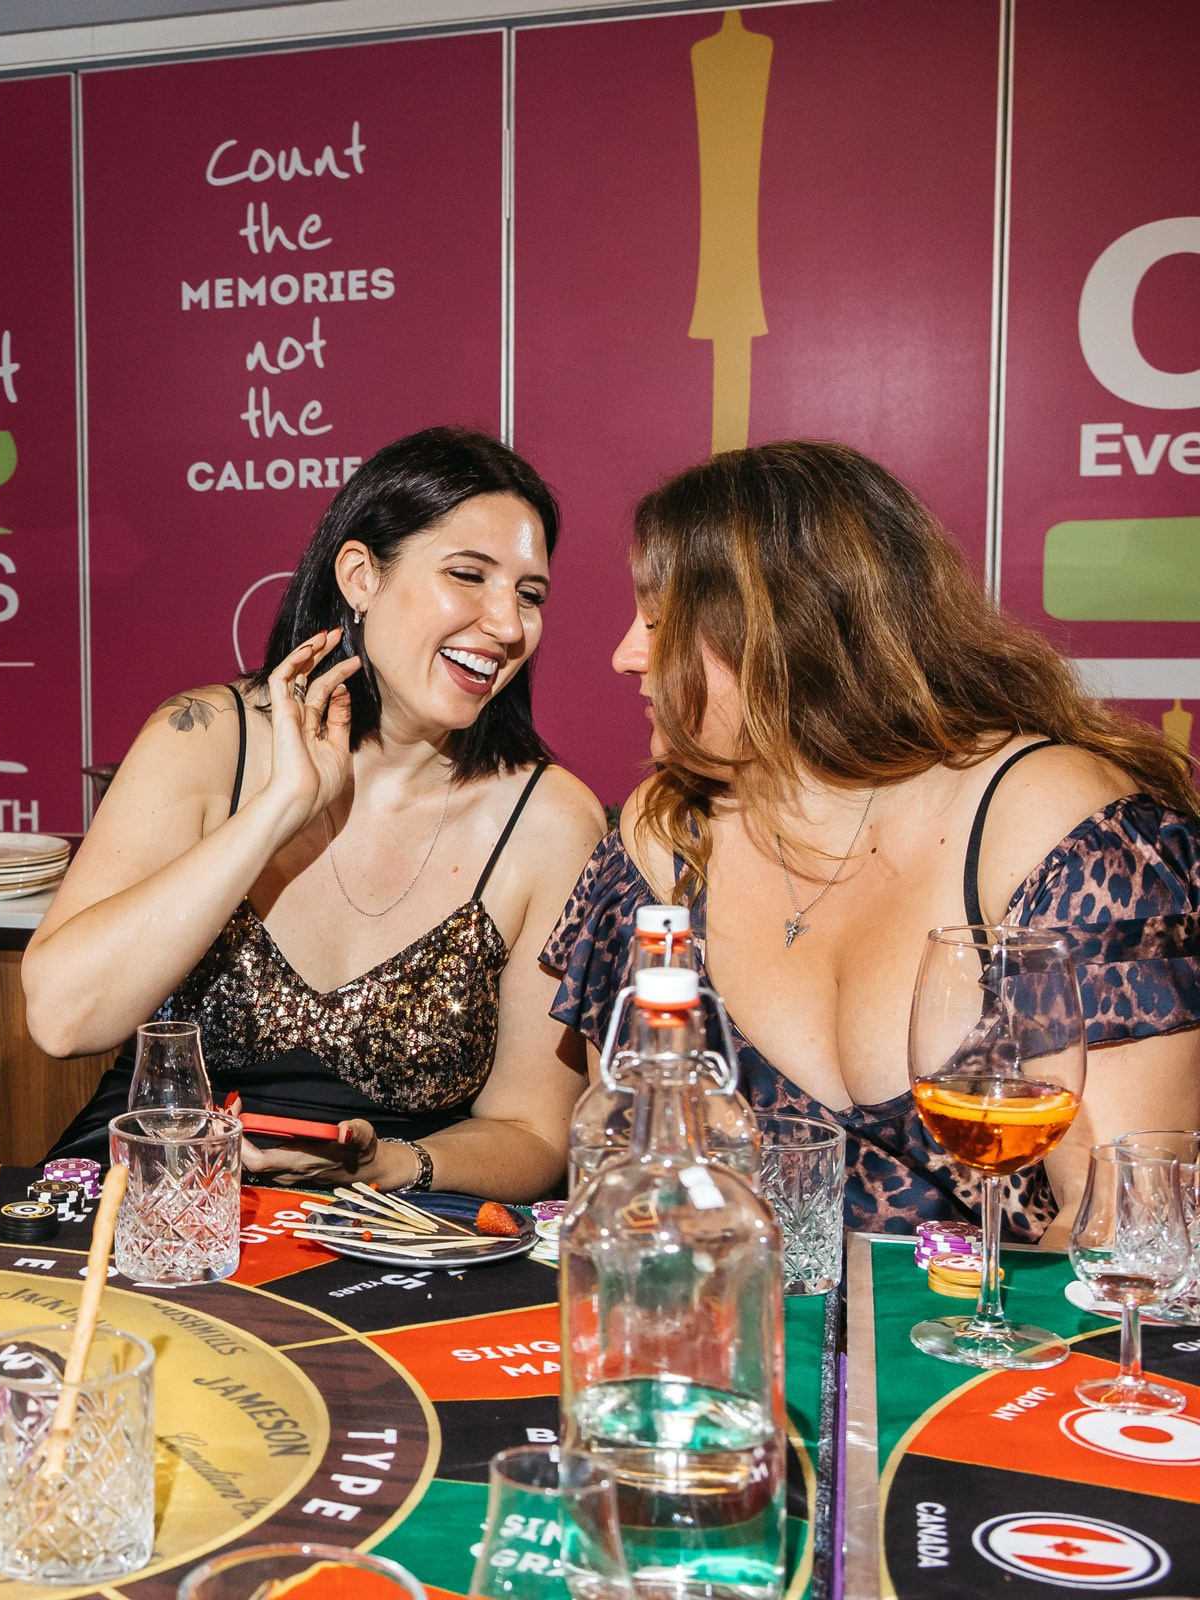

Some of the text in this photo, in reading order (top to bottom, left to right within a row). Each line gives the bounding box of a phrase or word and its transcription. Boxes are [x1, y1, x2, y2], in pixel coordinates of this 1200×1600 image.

[205, 120, 366, 187] Count
[239, 201, 333, 255] the
[181, 267, 396, 311] MEMORIES
[244, 316, 328, 375] not
[240, 386, 334, 439] the
[186, 455, 362, 492] CALORIE
[327, 1270, 468, 1299] -5 YEARS
[451, 1341, 561, 1362] SING
[499, 1361, 561, 1377] MA
[193, 1376, 311, 1457] JAMESON
[988, 1386, 1056, 1421] JAPAN
[302, 1429, 398, 1522] TYPE
[499, 1513, 564, 1546] SIN
[916, 1501, 949, 1569] CANADA
